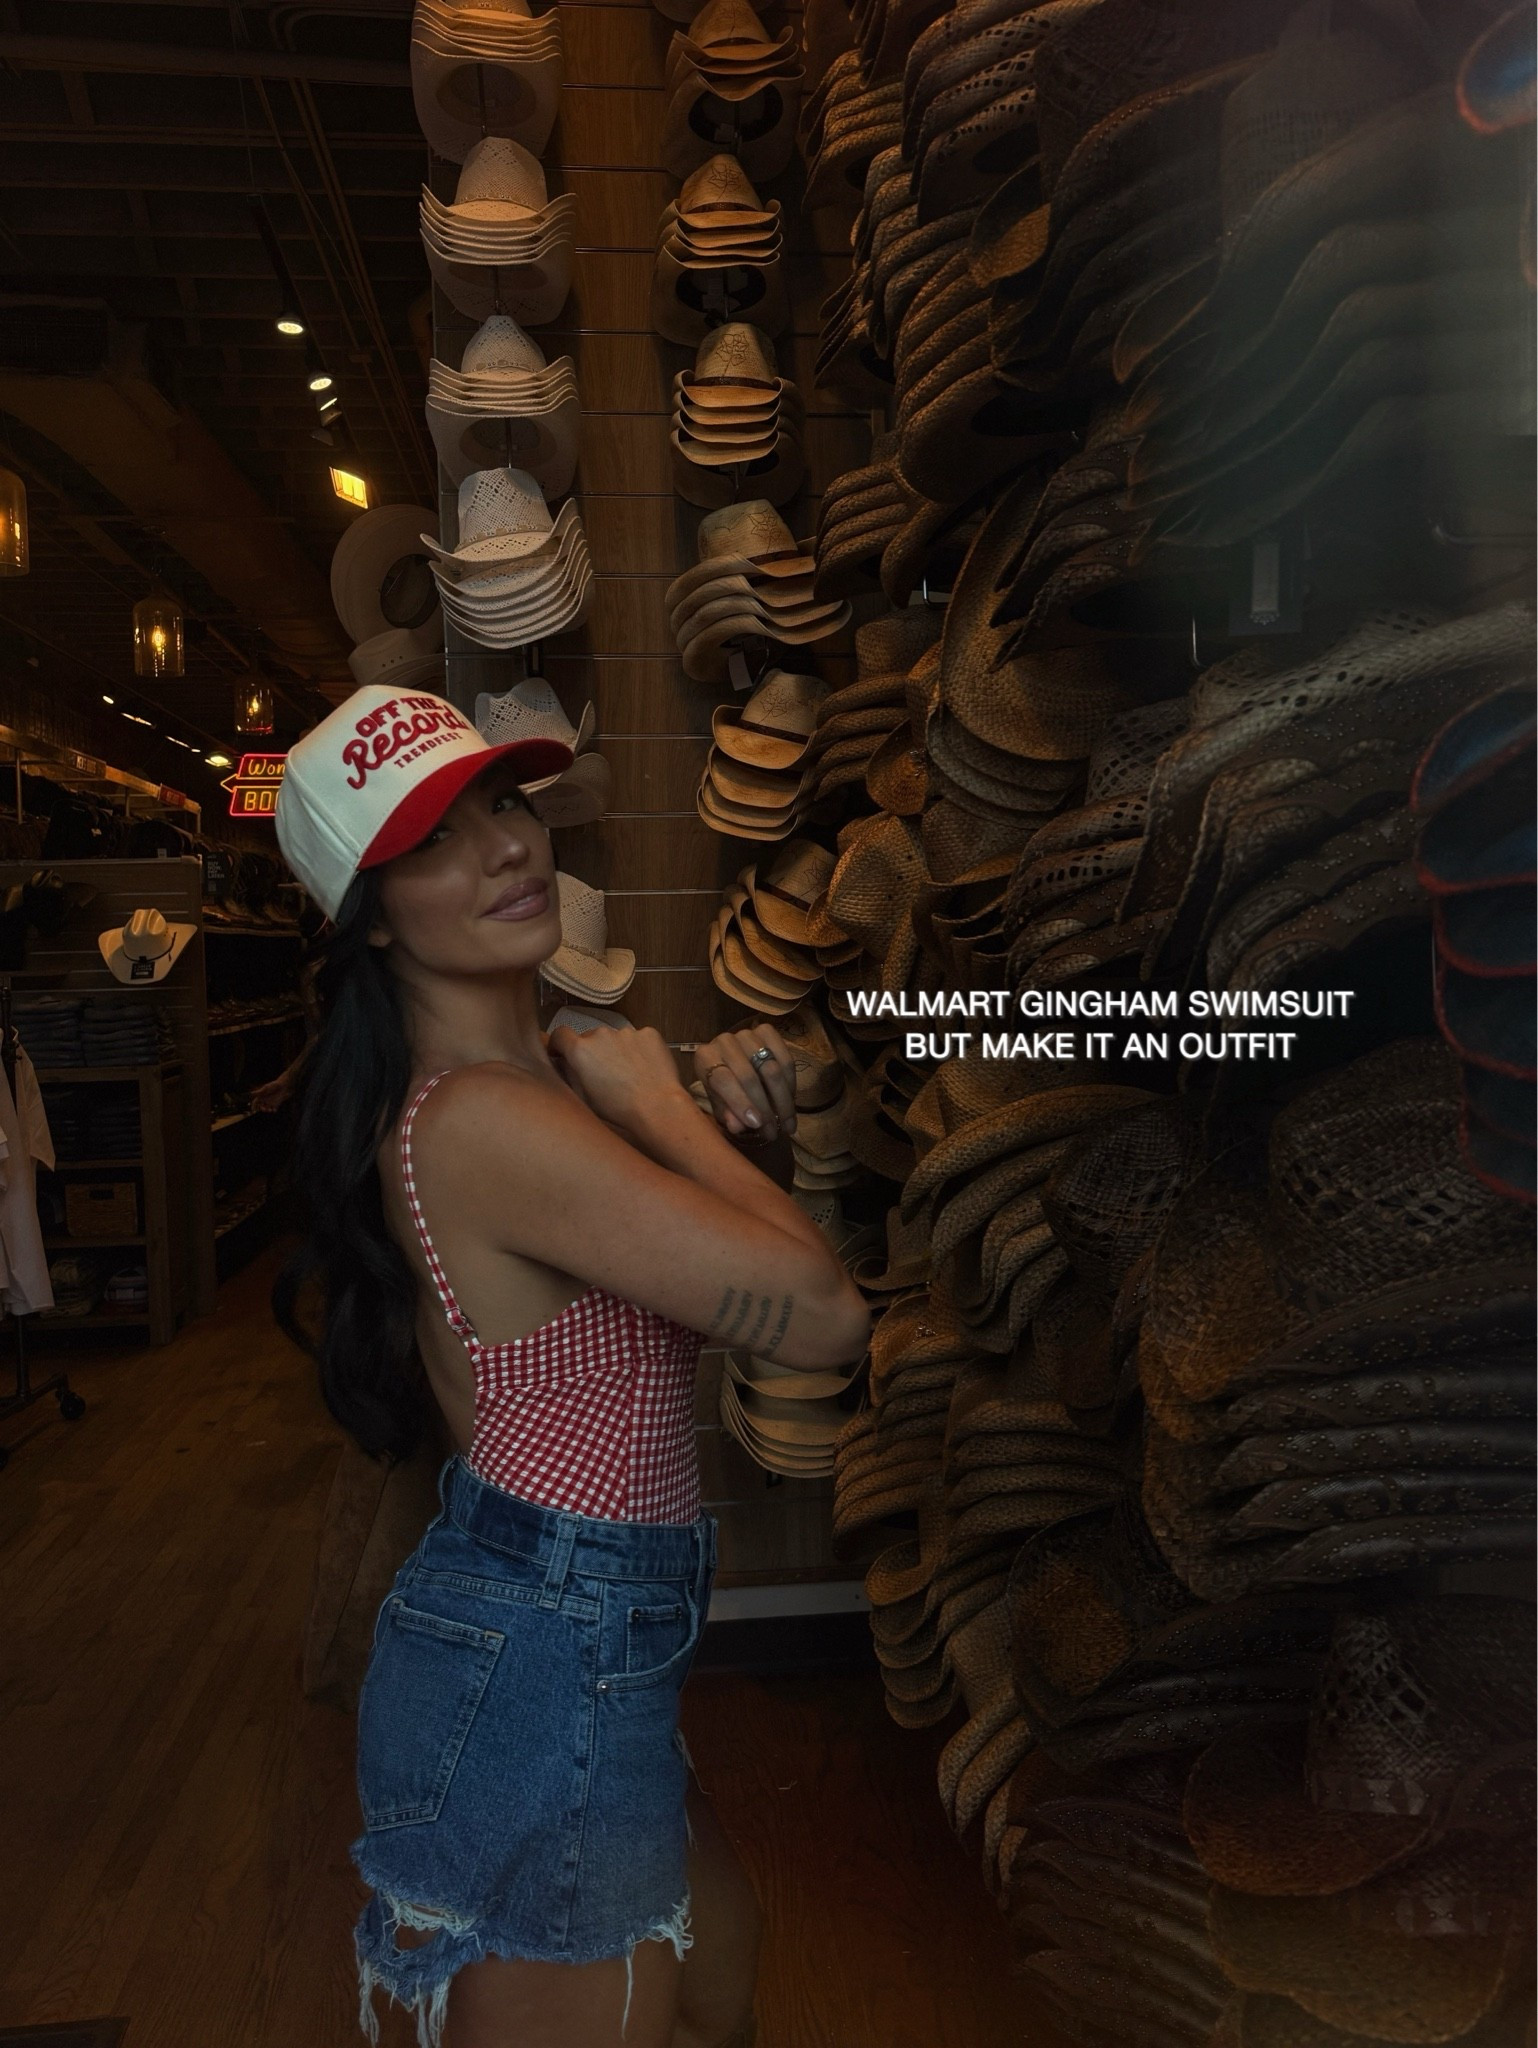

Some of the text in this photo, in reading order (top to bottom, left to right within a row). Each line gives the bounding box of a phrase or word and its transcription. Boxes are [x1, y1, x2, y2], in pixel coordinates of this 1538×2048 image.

[355, 696, 443, 738] OFF THE
[393, 732, 463, 768] TRENDFEST
[244, 791, 279, 811] BO
